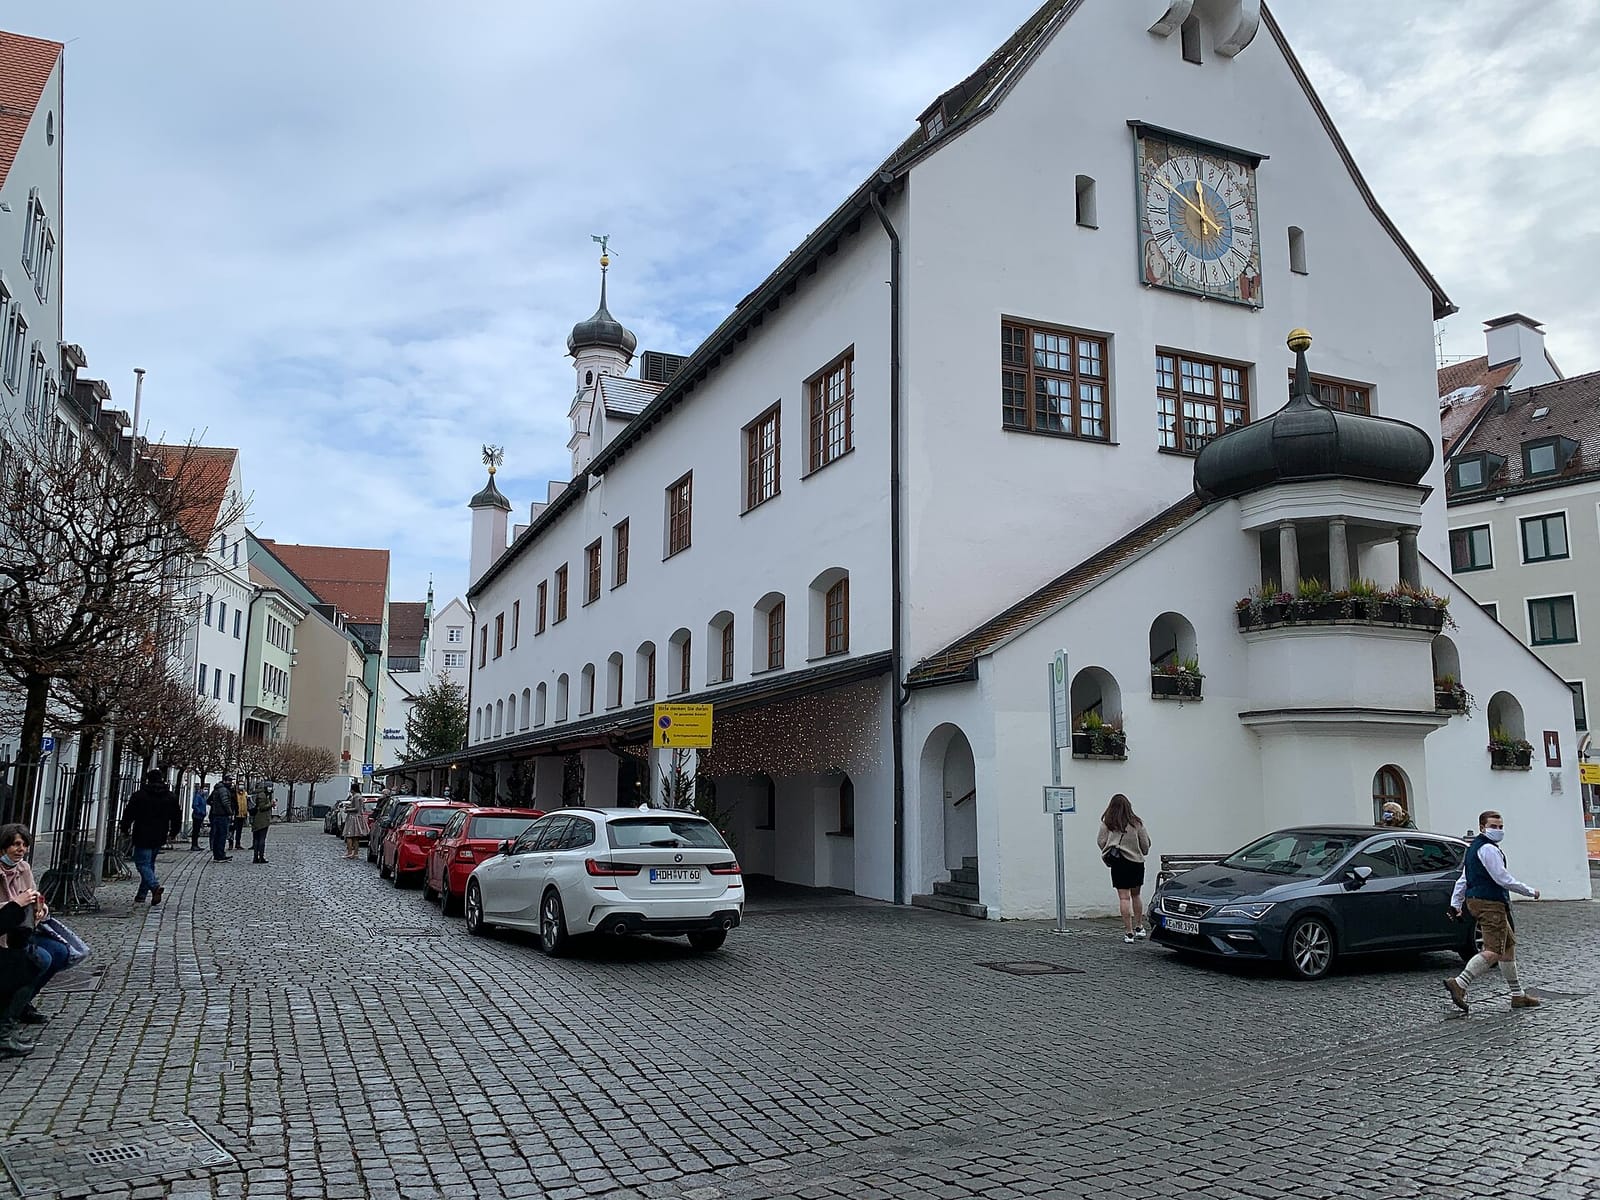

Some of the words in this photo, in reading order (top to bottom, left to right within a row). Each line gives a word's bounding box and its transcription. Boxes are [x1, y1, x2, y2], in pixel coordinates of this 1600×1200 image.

[43, 738, 52, 750] P
[656, 870, 673, 880] HDH
[676, 870, 689, 880] VT
[689, 870, 700, 880] 60
